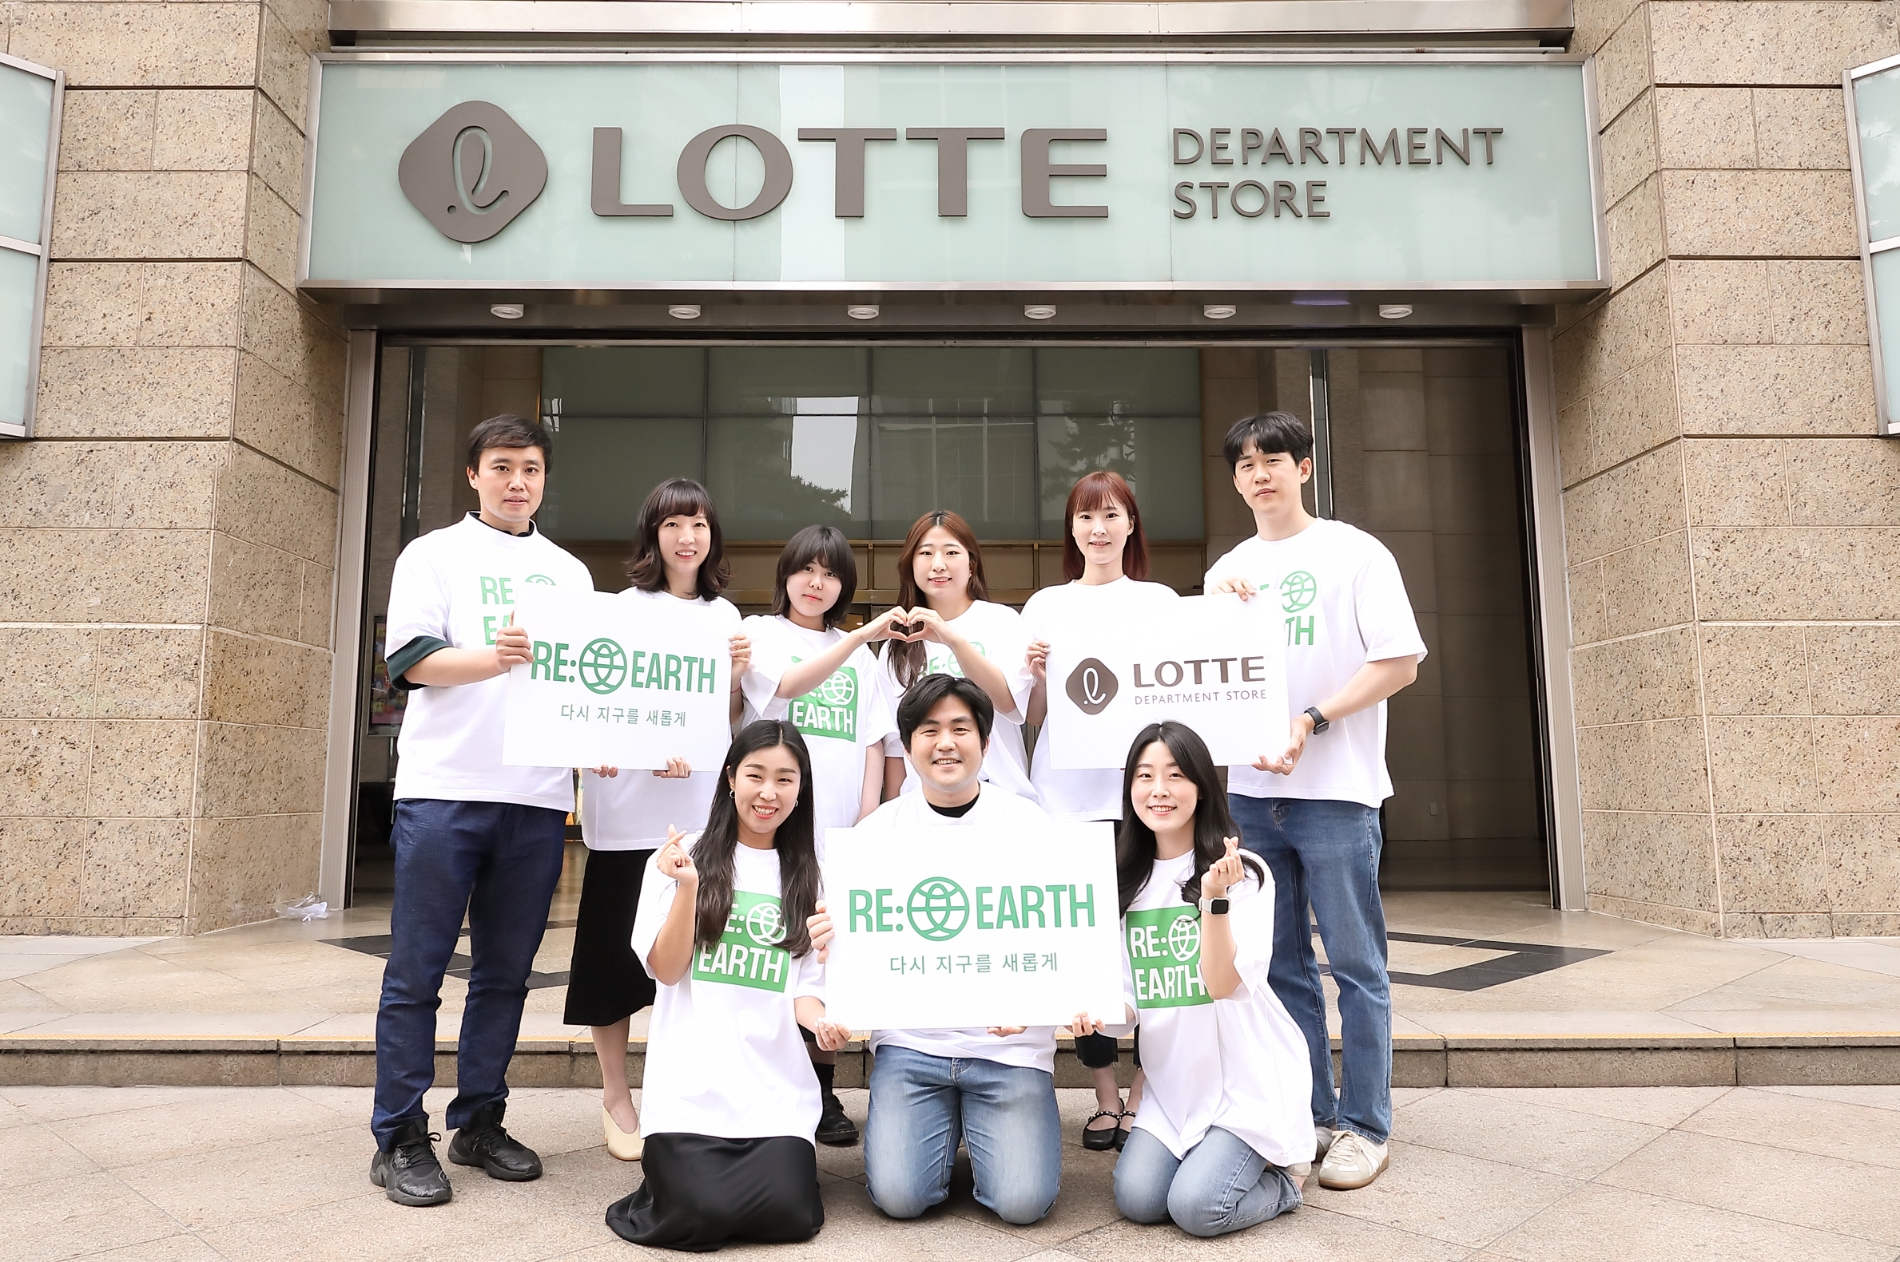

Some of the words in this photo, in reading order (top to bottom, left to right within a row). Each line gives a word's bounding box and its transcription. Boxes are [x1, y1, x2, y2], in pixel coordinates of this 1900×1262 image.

[1172, 127, 1504, 166] DEPARTMENT
[590, 124, 1109, 221] LOTTE
[1172, 180, 1331, 220] STORE
[531, 640, 577, 683] RE:
[631, 650, 716, 694] EARTH
[1133, 655, 1266, 688] LOTTE
[560, 703, 590, 722] 다시
[597, 705, 640, 725] 지구를
[645, 709, 687, 728] 새롭게
[1134, 691, 1220, 706] DEPARTMENT
[1226, 689, 1267, 701] STORE
[792, 700, 854, 735] EARTH
[848, 888, 904, 933] RE:
[975, 883, 1096, 930] EARTH
[1130, 925, 1169, 958] RE:
[698, 942, 785, 984] EARTH
[890, 955, 926, 975] 다시
[936, 954, 993, 975] 지구를
[1002, 952, 1058, 973] 새롭게
[1134, 964, 1207, 1001] EARTH
